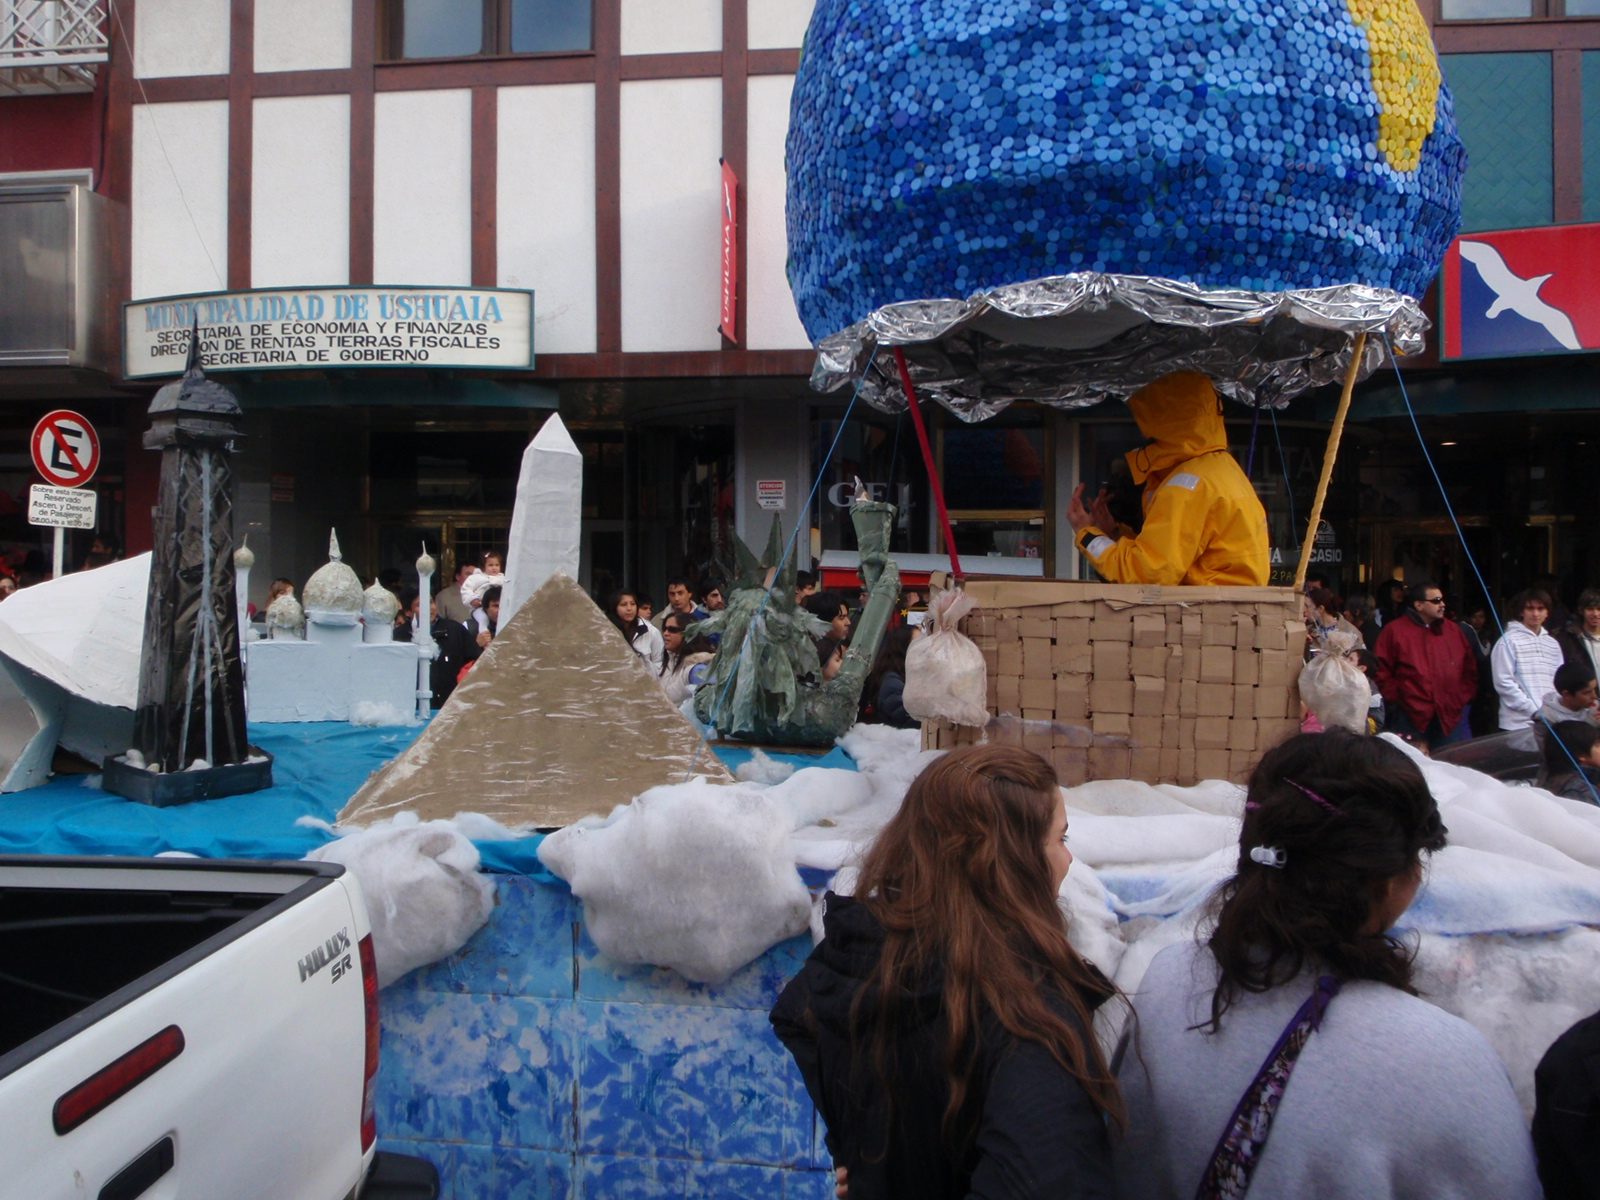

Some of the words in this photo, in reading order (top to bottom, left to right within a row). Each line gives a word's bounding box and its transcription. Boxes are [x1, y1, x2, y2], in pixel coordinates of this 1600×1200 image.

[723, 225, 731, 323] USHUAIA
[144, 294, 325, 332] MUNICIPALIDAD
[333, 294, 369, 321] DE
[377, 294, 503, 322] USHUAIA
[157, 325, 242, 343] SECRTARIA
[250, 323, 273, 336] DE
[281, 321, 369, 336] ECONOMIA
[376, 321, 387, 334] Y
[395, 321, 488, 336] FINANZAS
[151, 341, 219, 358] DIRECON
[224, 338, 246, 351] DE
[251, 336, 316, 350] RENTAS
[326, 335, 402, 348] TIERRAS
[409, 336, 501, 350] FISCALES
[200, 350, 297, 366] SECRETARIA
[306, 349, 330, 362] DE
[339, 349, 430, 362] GOBIERNO
[32, 486, 54, 494] Sobre
[43, 494, 82, 504] Reservado
[50, 510, 83, 519] Pasajeros
[1308, 548, 1343, 563] CASIO
[297, 926, 351, 983] HILUX
[331, 953, 353, 984] SR
